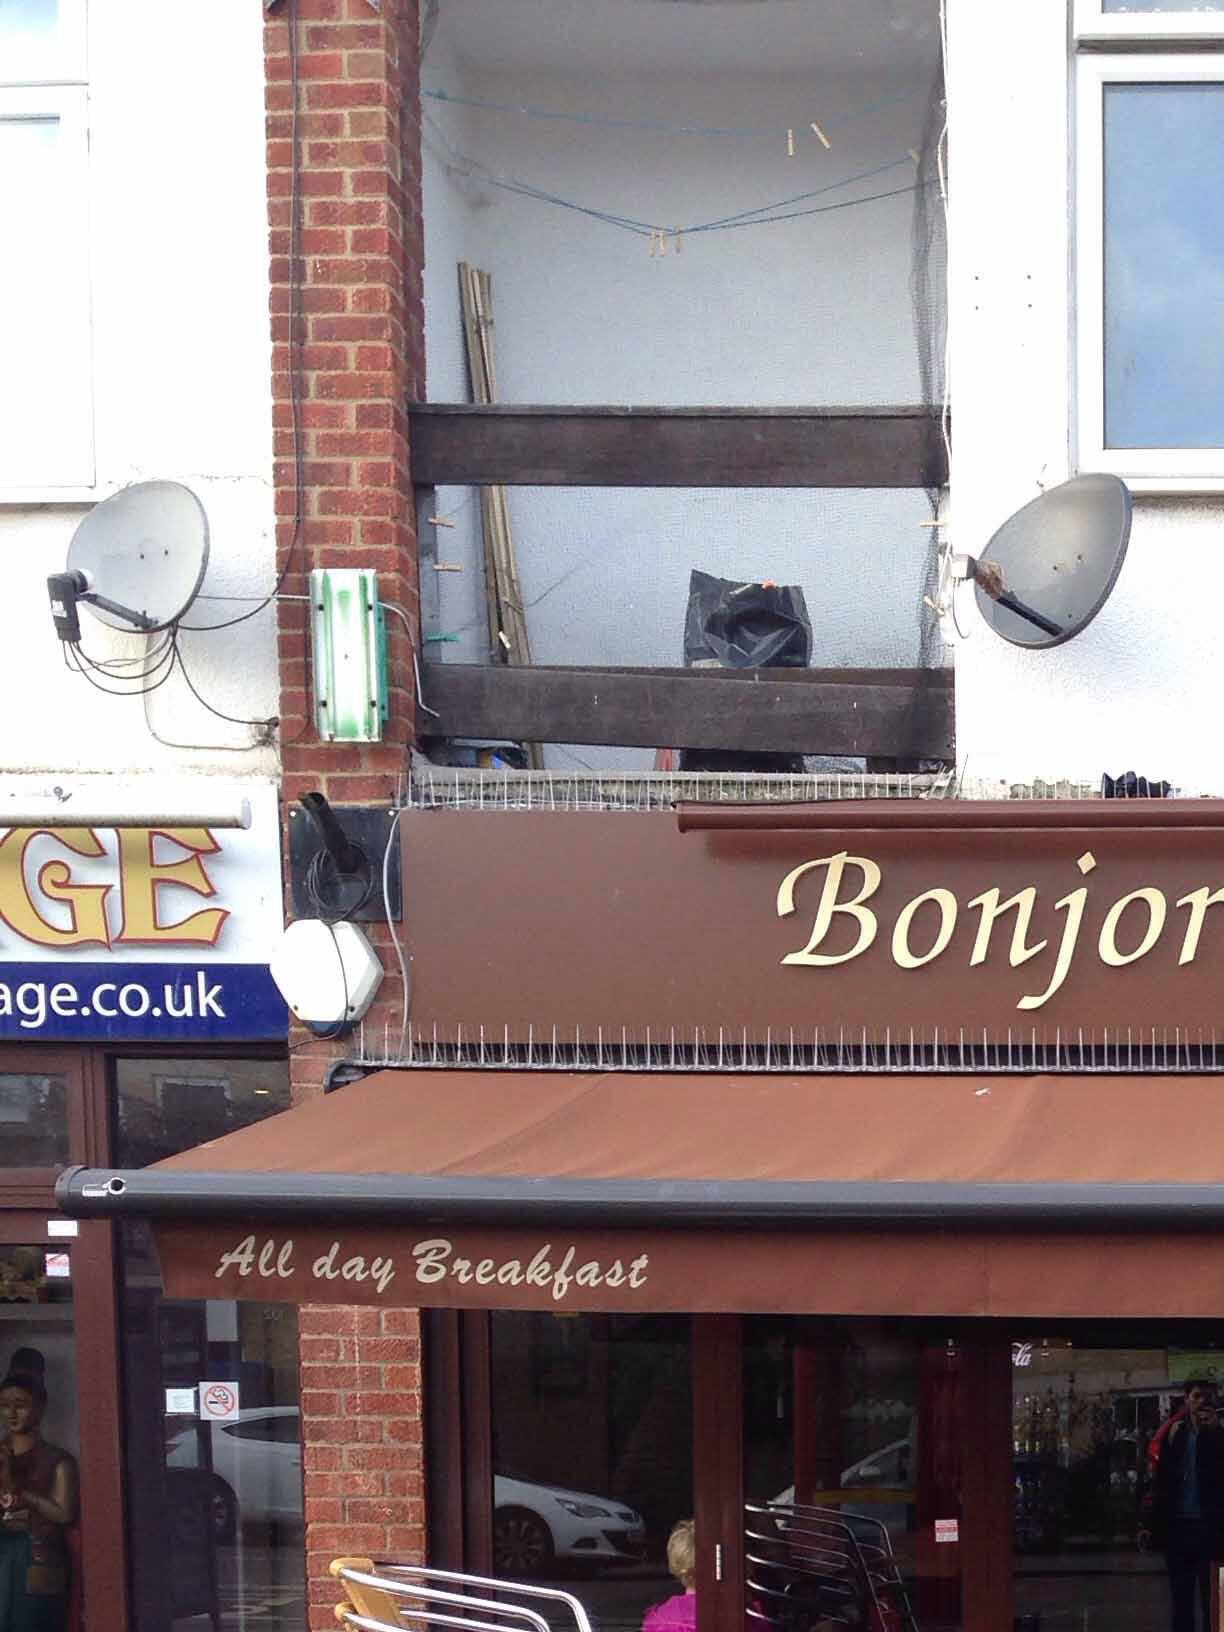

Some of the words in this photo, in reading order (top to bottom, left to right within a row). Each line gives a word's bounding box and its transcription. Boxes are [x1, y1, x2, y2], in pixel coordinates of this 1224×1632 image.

[215, 1235, 294, 1278] All
[312, 1242, 397, 1293] day
[412, 1239, 649, 1301] Breakfast
